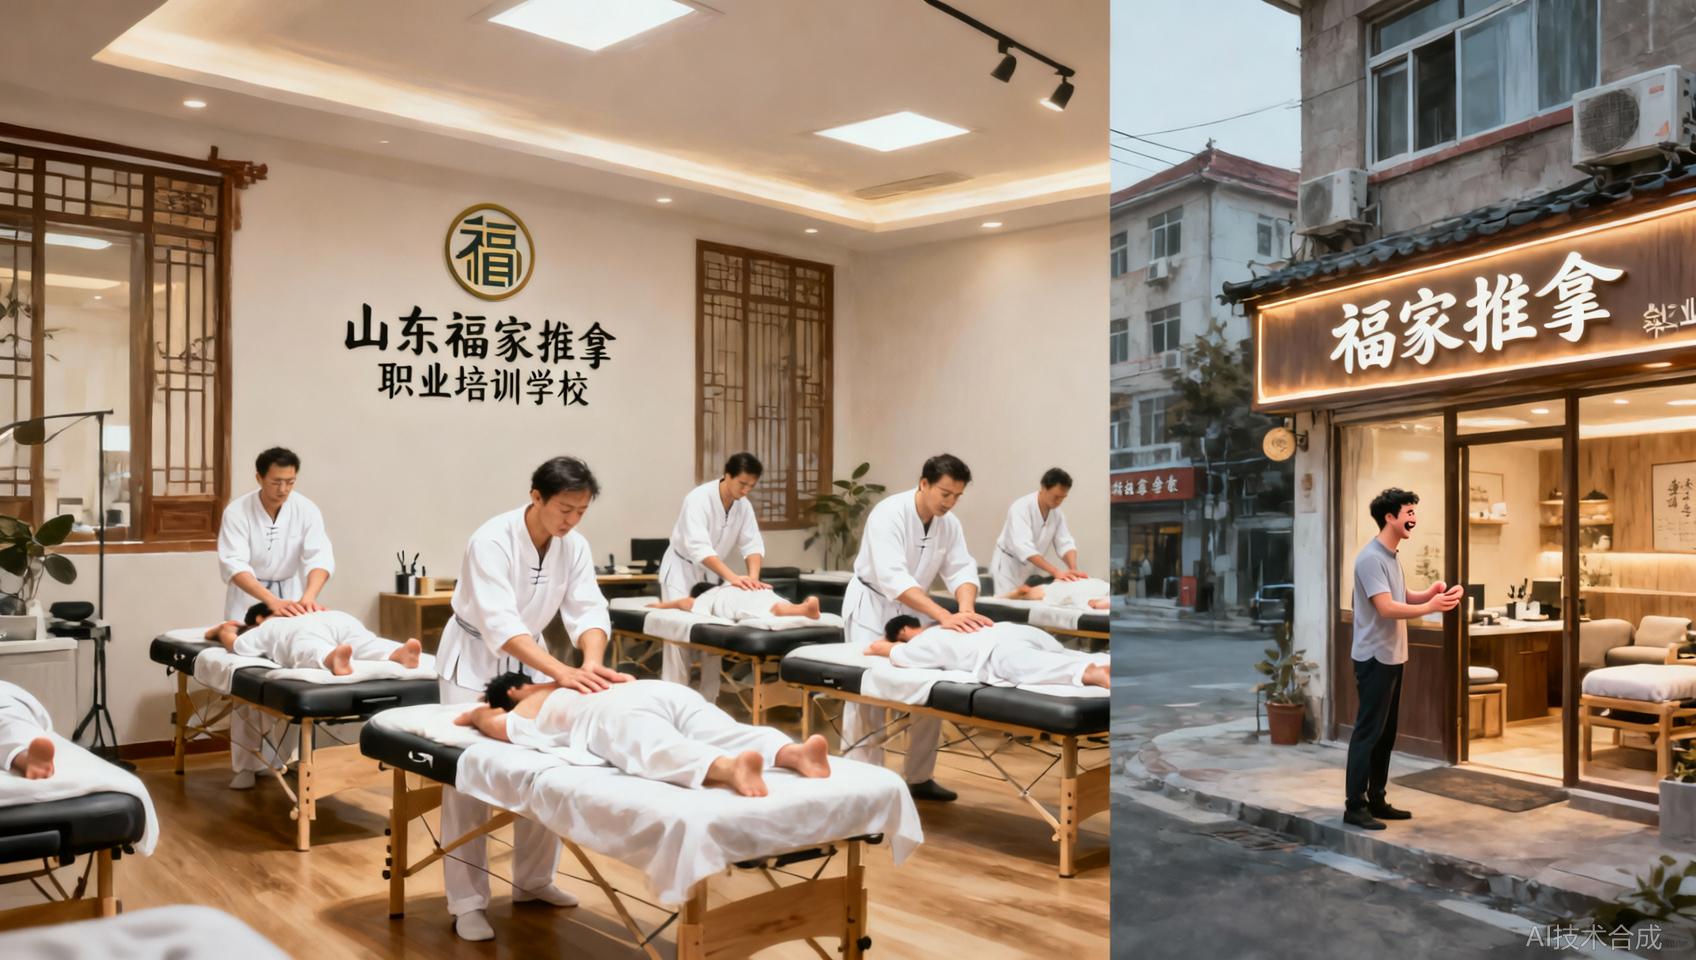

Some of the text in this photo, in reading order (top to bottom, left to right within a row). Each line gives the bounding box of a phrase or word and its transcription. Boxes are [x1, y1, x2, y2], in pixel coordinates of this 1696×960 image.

[345, 303, 616, 370] 山东福家推拿
[1330, 251, 1624, 374] 福家推拿
[378, 362, 589, 406] 职业培训学校
